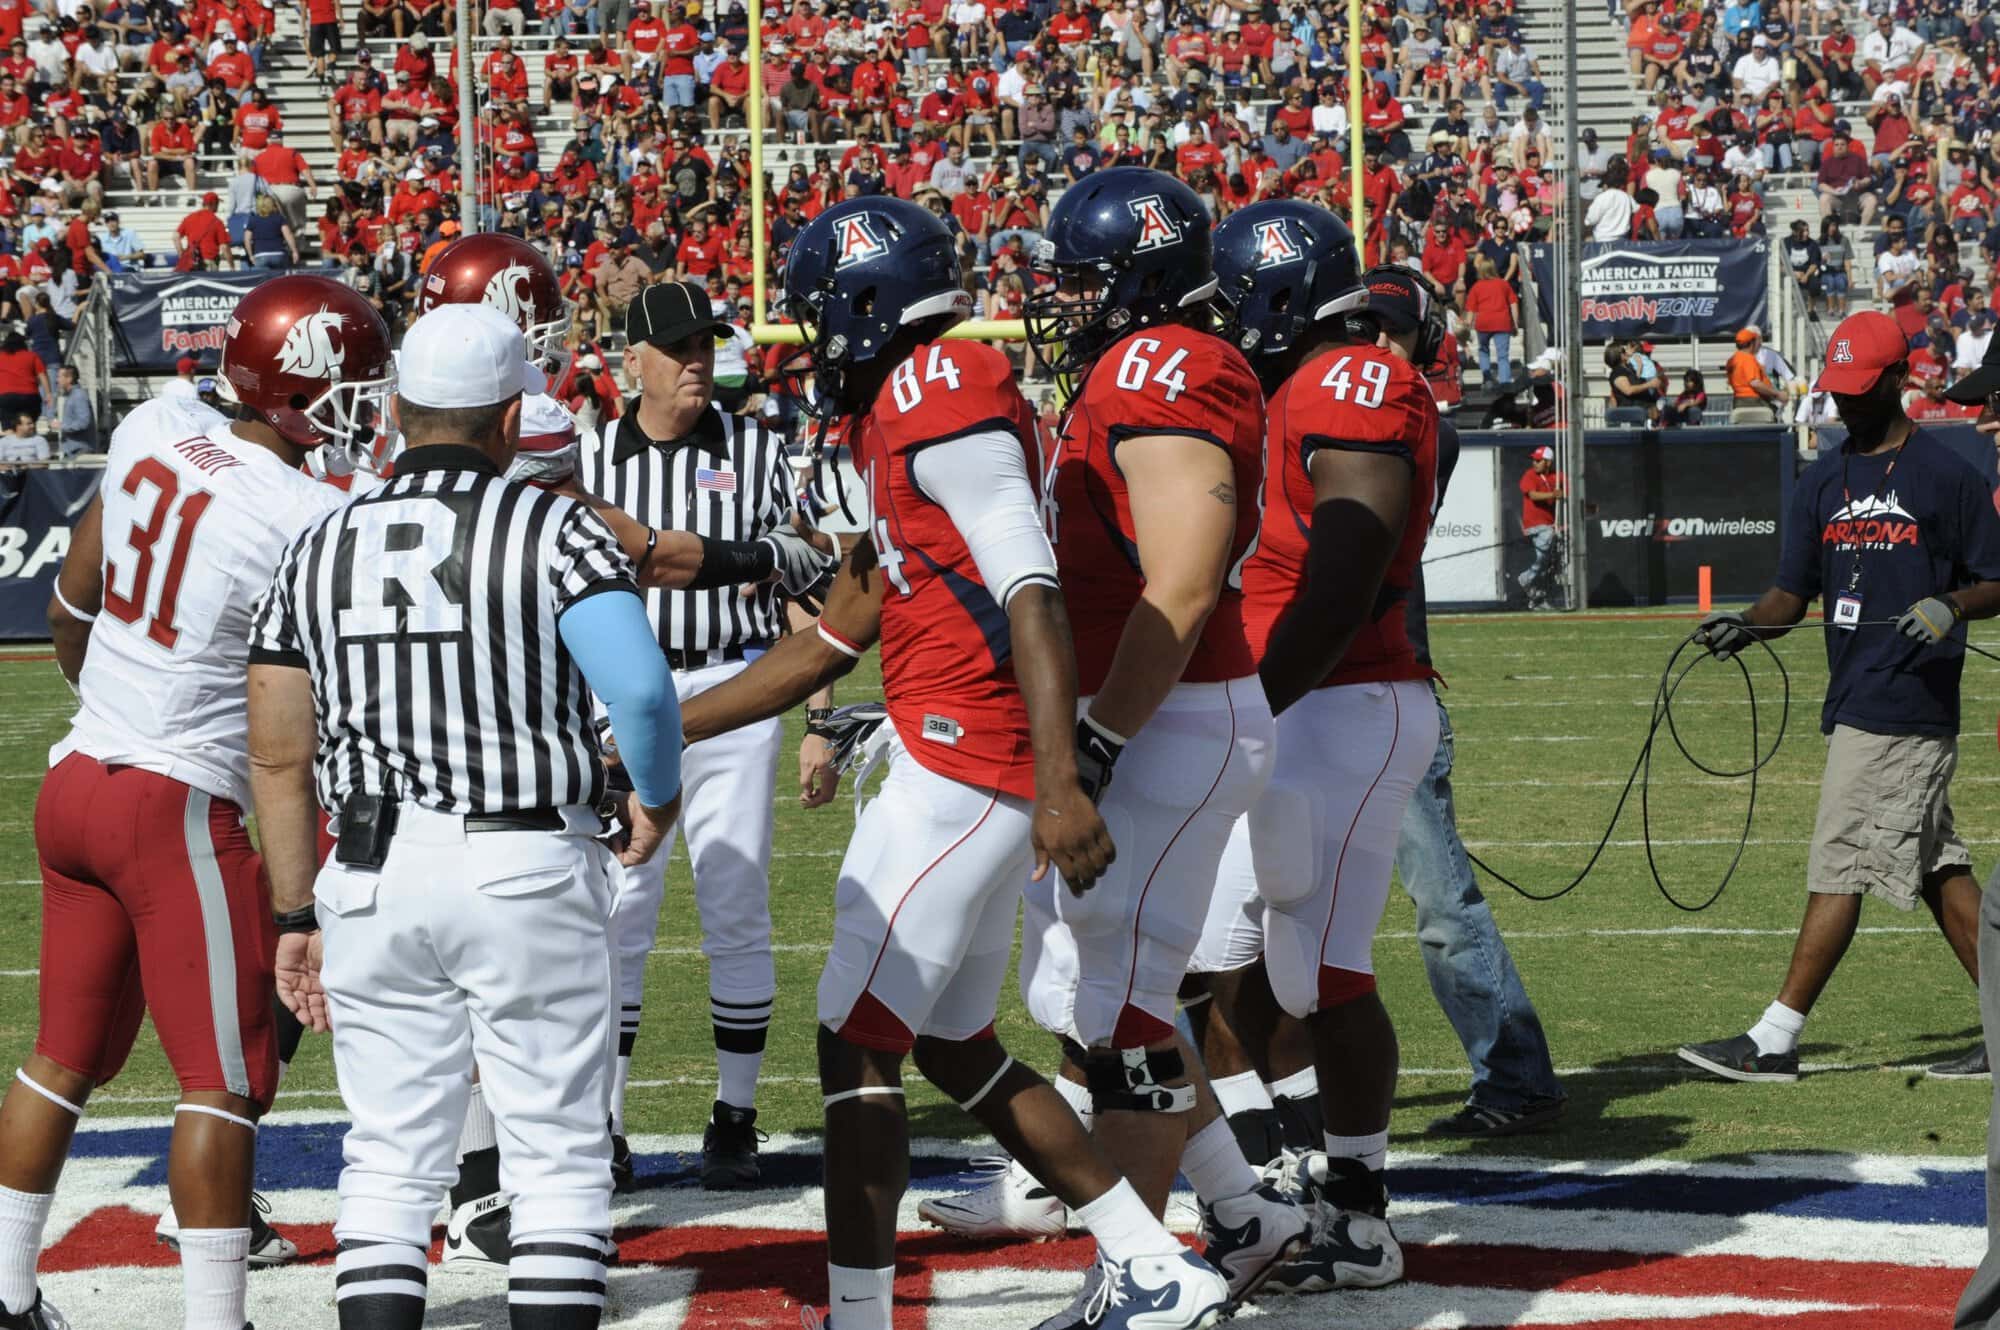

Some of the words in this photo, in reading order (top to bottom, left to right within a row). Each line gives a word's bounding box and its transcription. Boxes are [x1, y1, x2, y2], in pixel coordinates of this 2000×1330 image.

[832, 210, 889, 272] A
[1127, 194, 1183, 255] A
[1252, 217, 1303, 272] A
[1580, 266, 1659, 282] AMERICAN
[1664, 264, 1718, 279] FAMILY
[1591, 279, 1707, 292] INSURANCE
[161, 296, 239, 311] AMERICAN
[1116, 338, 1189, 402] 64
[1832, 339, 1853, 363] A
[892, 345, 961, 414] 84
[1321, 356, 1390, 409] 49
[103, 455, 216, 654] 31
[1822, 520, 1919, 548] ARIZONA
[339, 498, 463, 637] R
[929, 719, 949, 733] 38
[475, 1196, 498, 1214] NIKE
